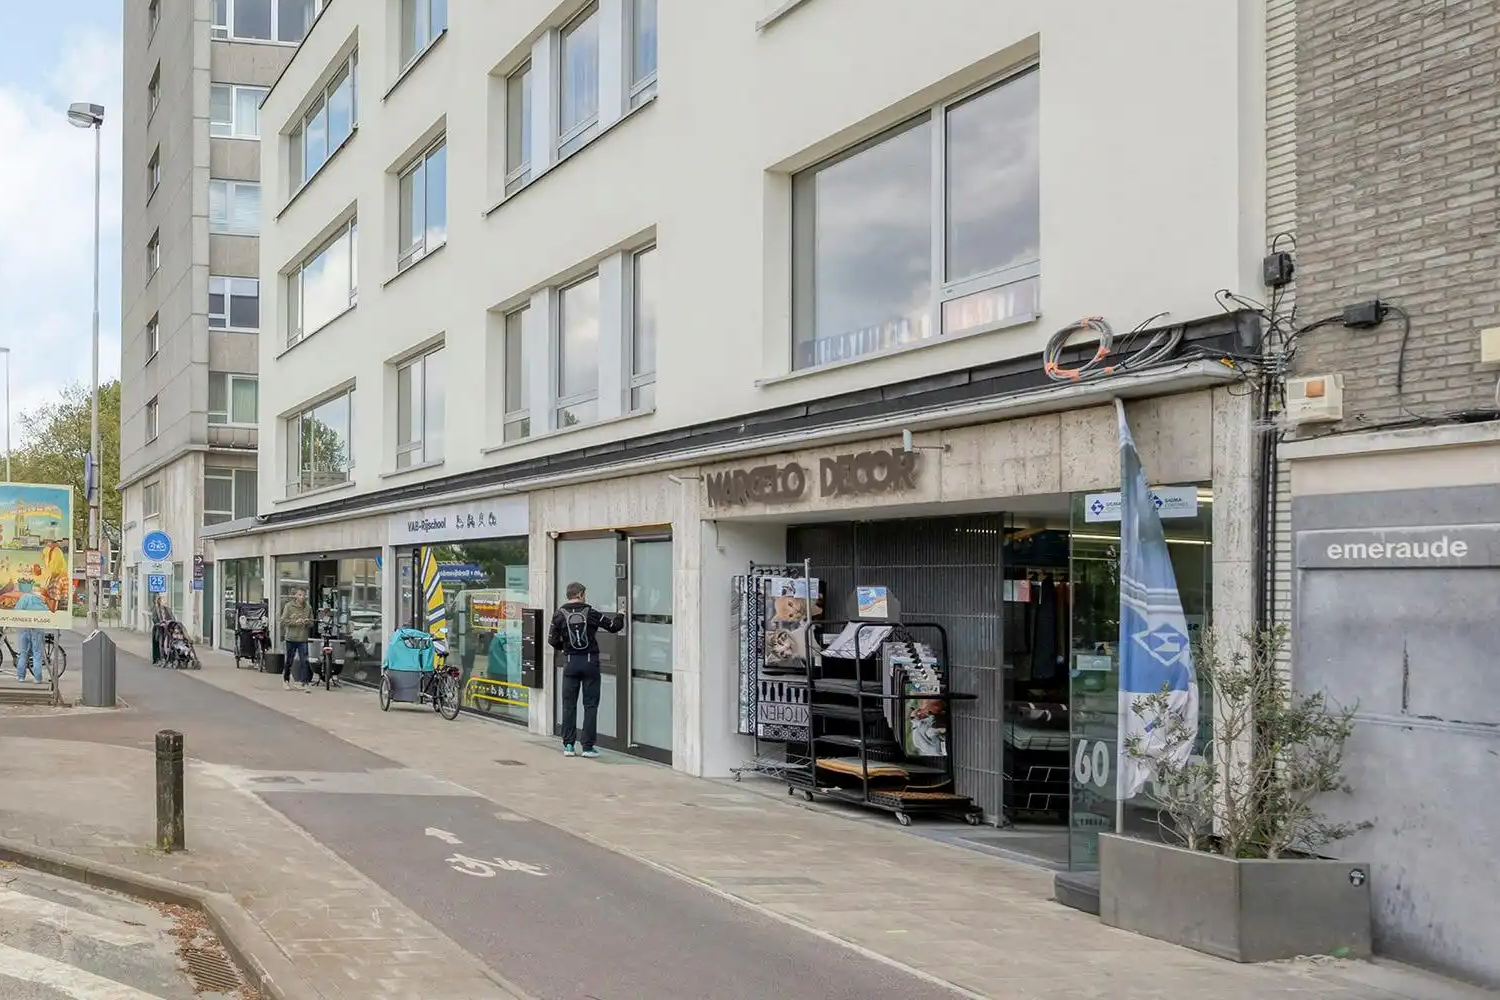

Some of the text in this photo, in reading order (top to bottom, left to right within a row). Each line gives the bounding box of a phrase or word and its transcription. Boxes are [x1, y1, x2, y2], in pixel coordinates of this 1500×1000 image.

[820, 447, 920, 498] DECOR
[407, 516, 447, 533] VAB-Rijschool
[1326, 534, 1469, 560] emeraude
[151, 576, 163, 585] 25
[760, 704, 810, 724] KITCHEN
[1074, 739, 1110, 787] 60
